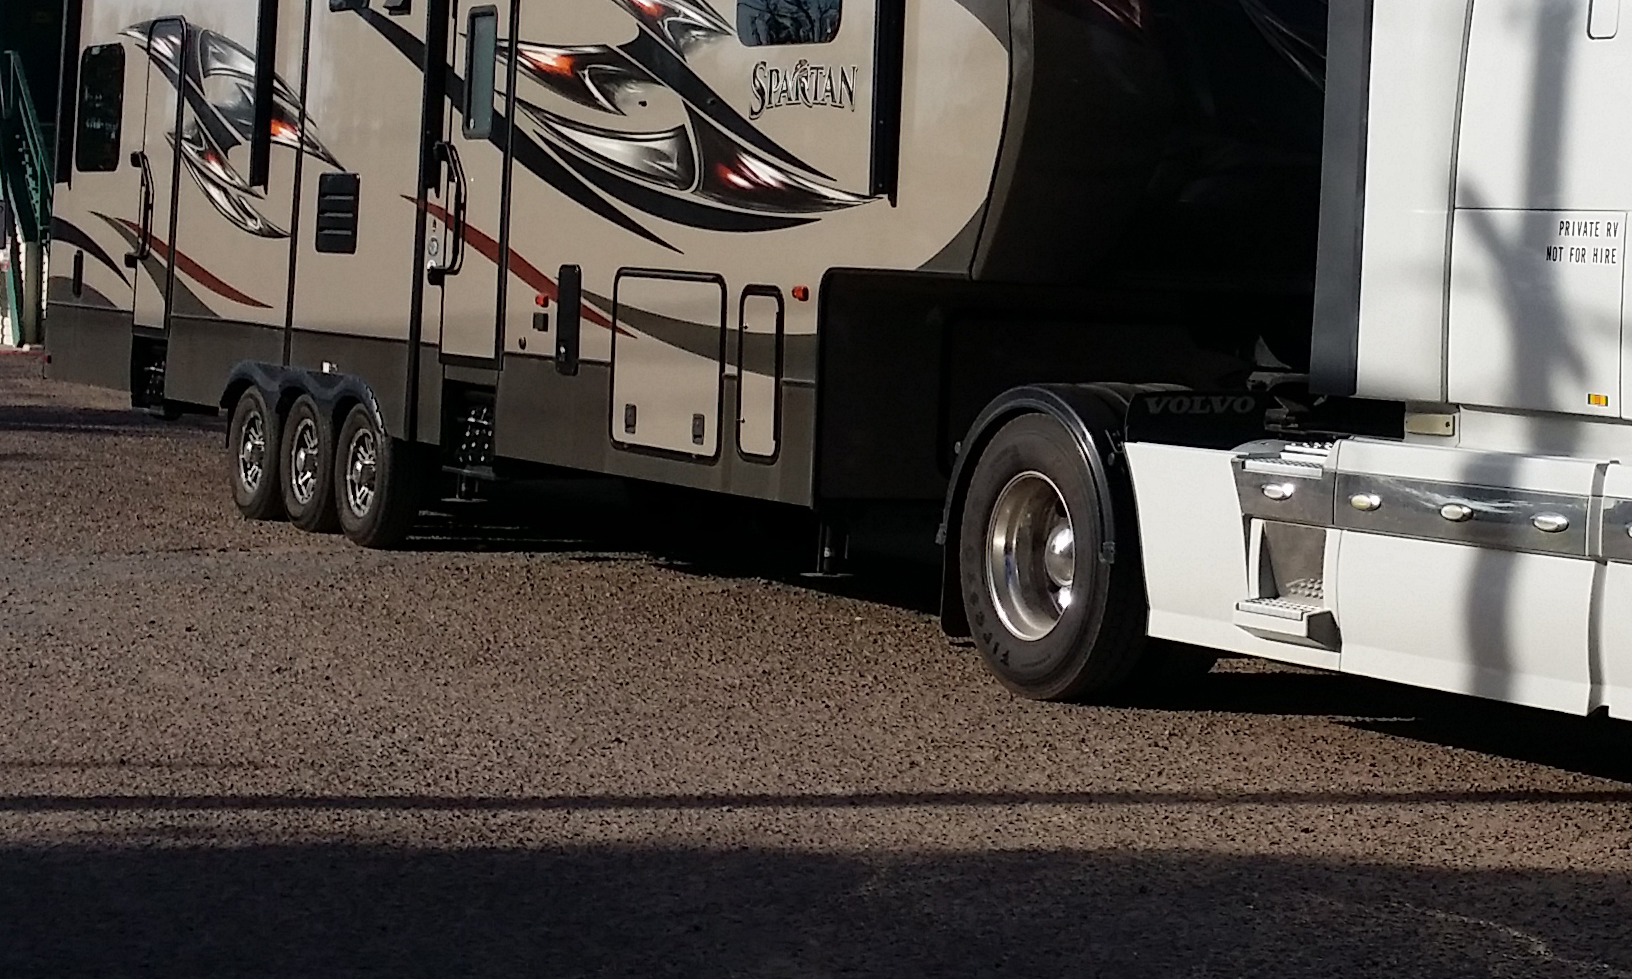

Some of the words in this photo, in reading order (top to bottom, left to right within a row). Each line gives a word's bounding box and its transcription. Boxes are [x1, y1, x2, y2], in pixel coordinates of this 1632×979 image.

[749, 59, 858, 120] SPARTAN
[1559, 220, 1601, 237] PRIVATE
[1606, 222, 1619, 237] RV
[1546, 246, 1564, 262] NOT
[1569, 247, 1586, 263] FOR
[1593, 248, 1617, 264] HIRE
[1144, 395, 1256, 415] VOLVO
